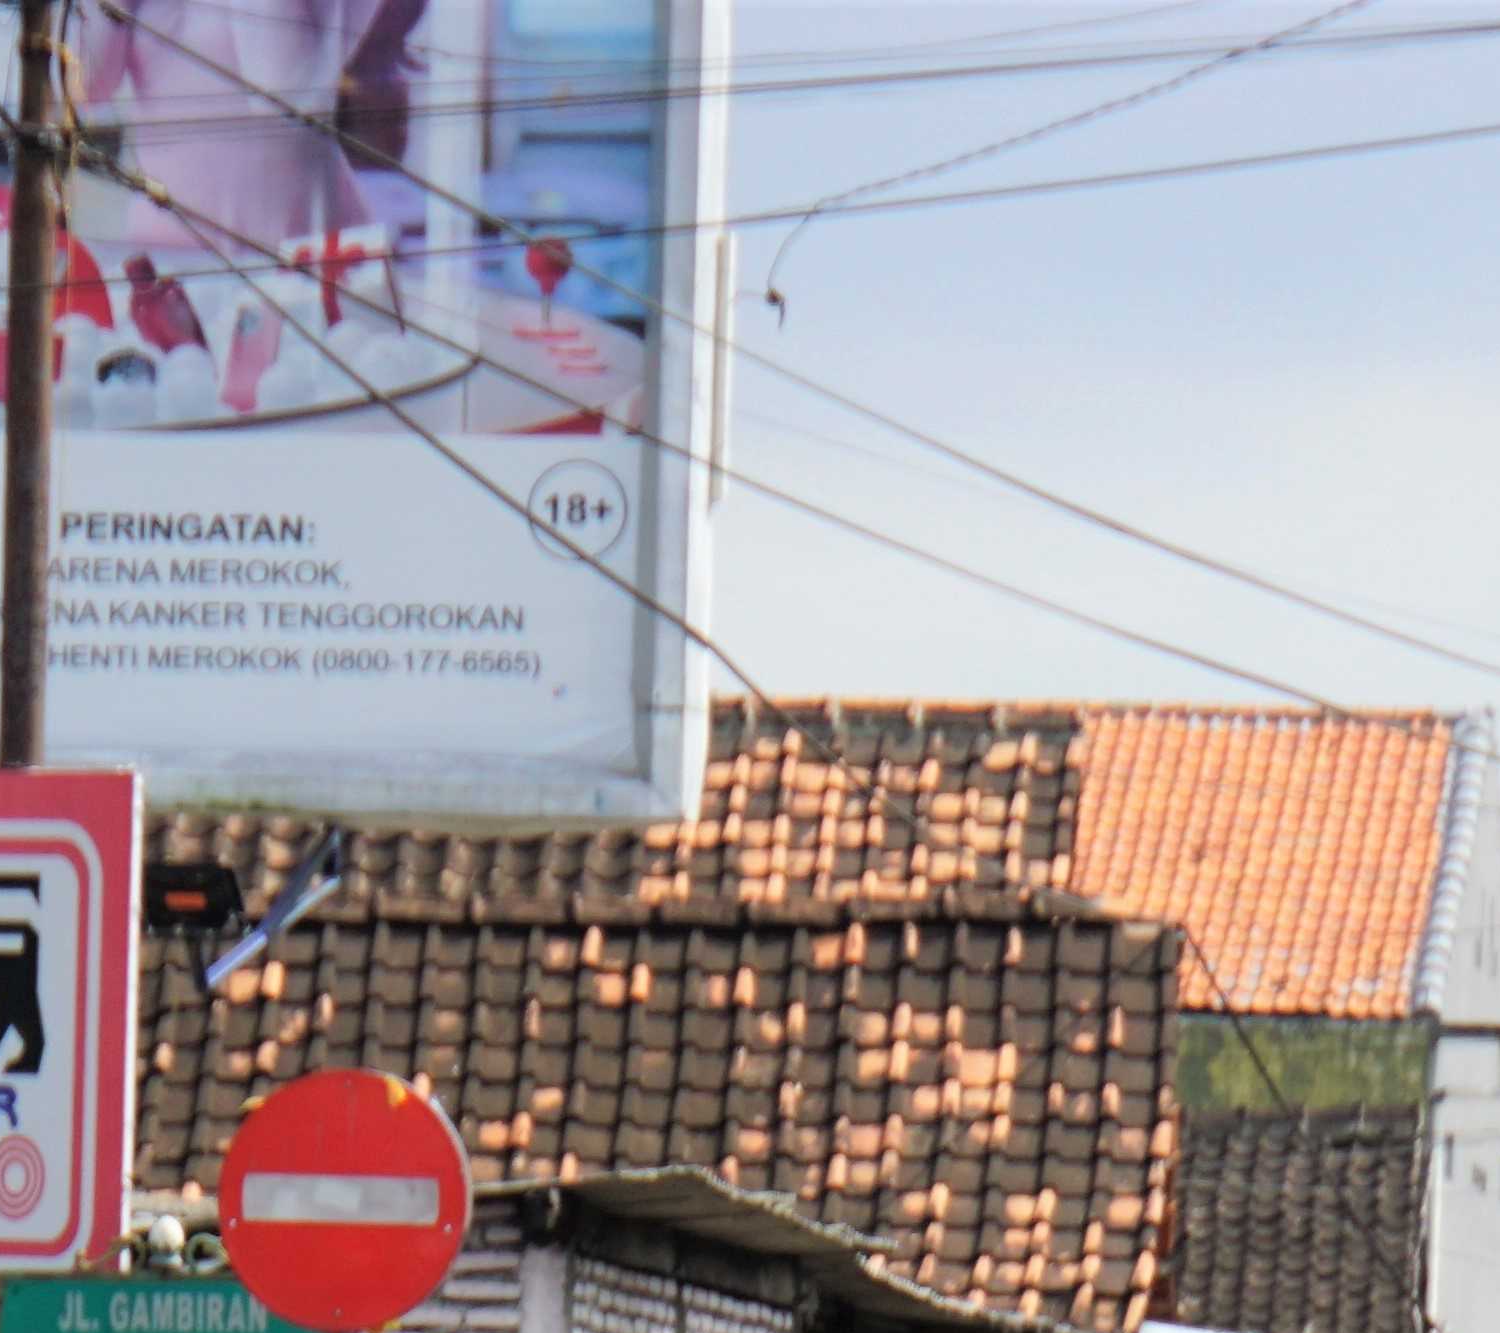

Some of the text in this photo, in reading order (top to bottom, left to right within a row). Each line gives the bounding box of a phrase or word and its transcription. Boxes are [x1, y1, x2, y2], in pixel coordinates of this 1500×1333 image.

[544, 493, 613, 526] 18+
[59, 511, 317, 544] PERINGATAN:
[170, 557, 351, 590] MEROKOK,
[108, 600, 246, 627] KANKER
[258, 601, 525, 632] TENGGOROKAN
[147, 645, 301, 671] MEROKOK
[57, 1289, 100, 1333] JL.
